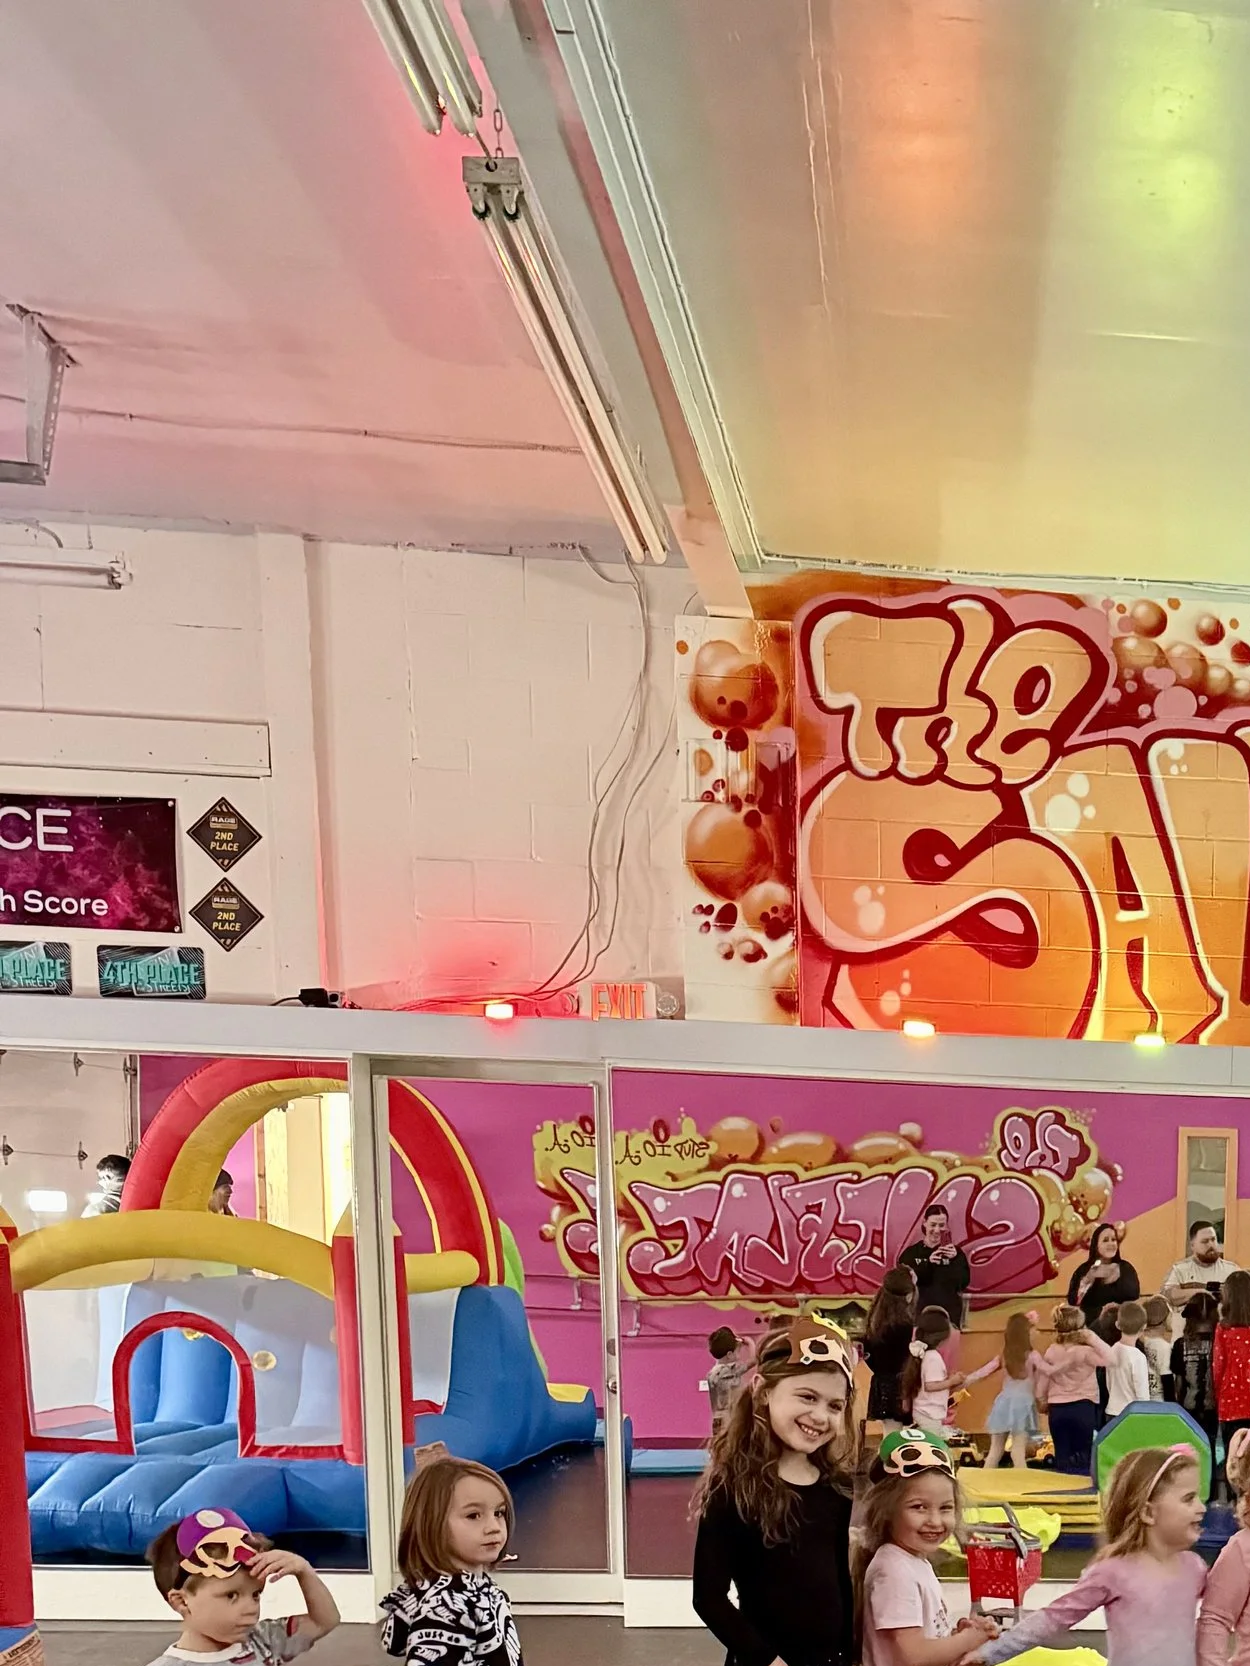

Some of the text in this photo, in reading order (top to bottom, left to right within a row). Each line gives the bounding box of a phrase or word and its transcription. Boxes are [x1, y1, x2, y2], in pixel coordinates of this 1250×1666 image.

[214, 831, 233, 841] 2ND
[210, 841, 239, 852] PLACE
[24, 889, 108, 916] Score
[216, 911, 235, 921] 2ND
[212, 921, 241, 932] PLACE
[592, 983, 647, 1022] EXIT
